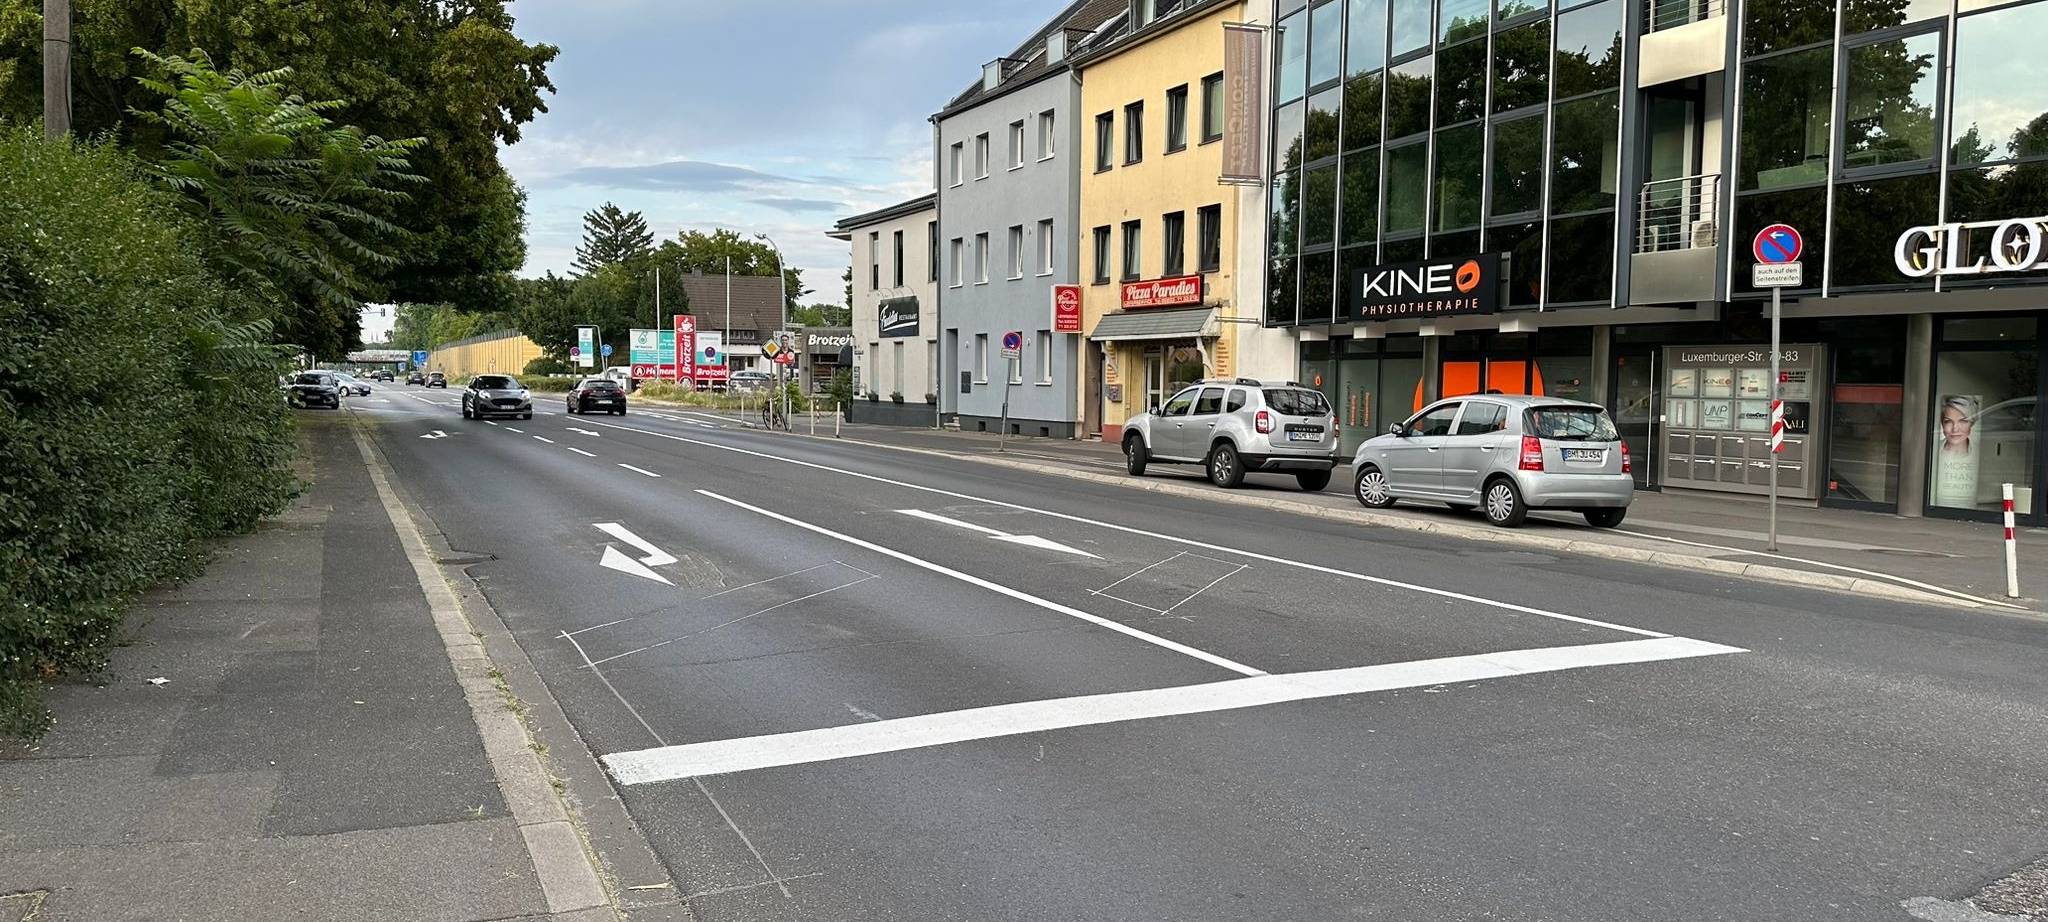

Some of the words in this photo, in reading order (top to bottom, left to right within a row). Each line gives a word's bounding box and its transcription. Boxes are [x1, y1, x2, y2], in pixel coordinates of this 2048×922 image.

[1894, 218, 2048, 278] GLO
[1126, 285, 1150, 300] Pizza
[1152, 281, 1196, 298] Paradies
[1361, 298, 1479, 316] PHYSIOTHERAPIE
[808, 334, 853, 347] Brotzeit
[682, 334, 692, 374] Brotzeit
[1681, 351, 1765, 364] Luxemburger-Str.
[1704, 405, 1728, 416] UNP
[1944, 462, 1976, 470] MORE
